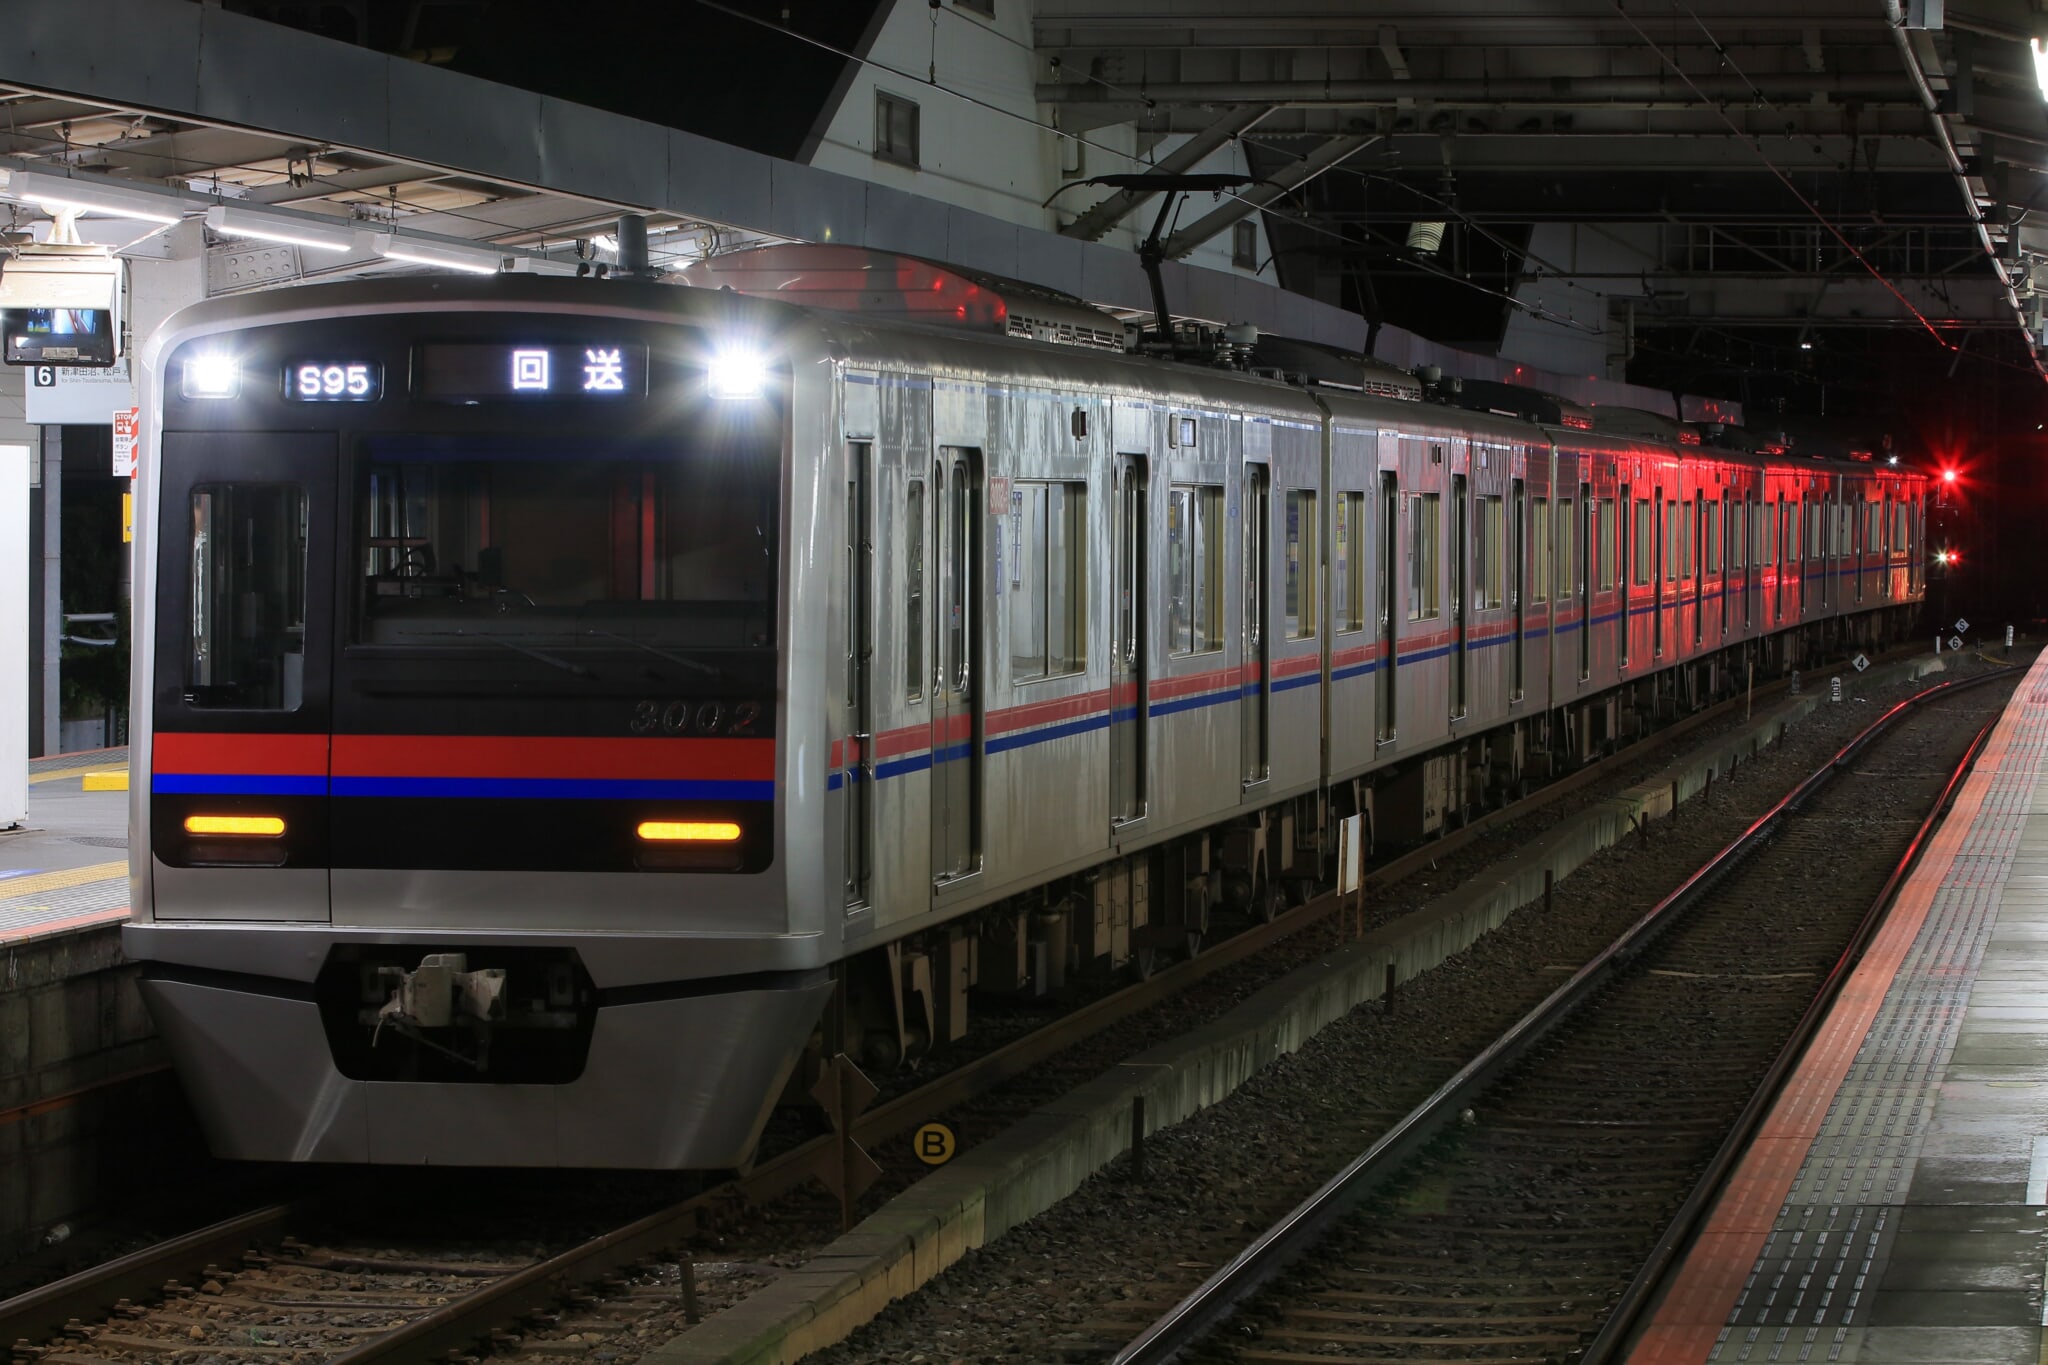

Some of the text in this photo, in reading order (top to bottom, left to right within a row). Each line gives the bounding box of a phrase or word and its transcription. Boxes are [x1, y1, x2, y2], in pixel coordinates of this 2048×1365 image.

[38, 366, 52, 386] 6
[299, 366, 369, 395] S95
[513, 349, 624, 390] 回送
[630, 699, 761, 735] 3002
[922, 1131, 946, 1157] B
